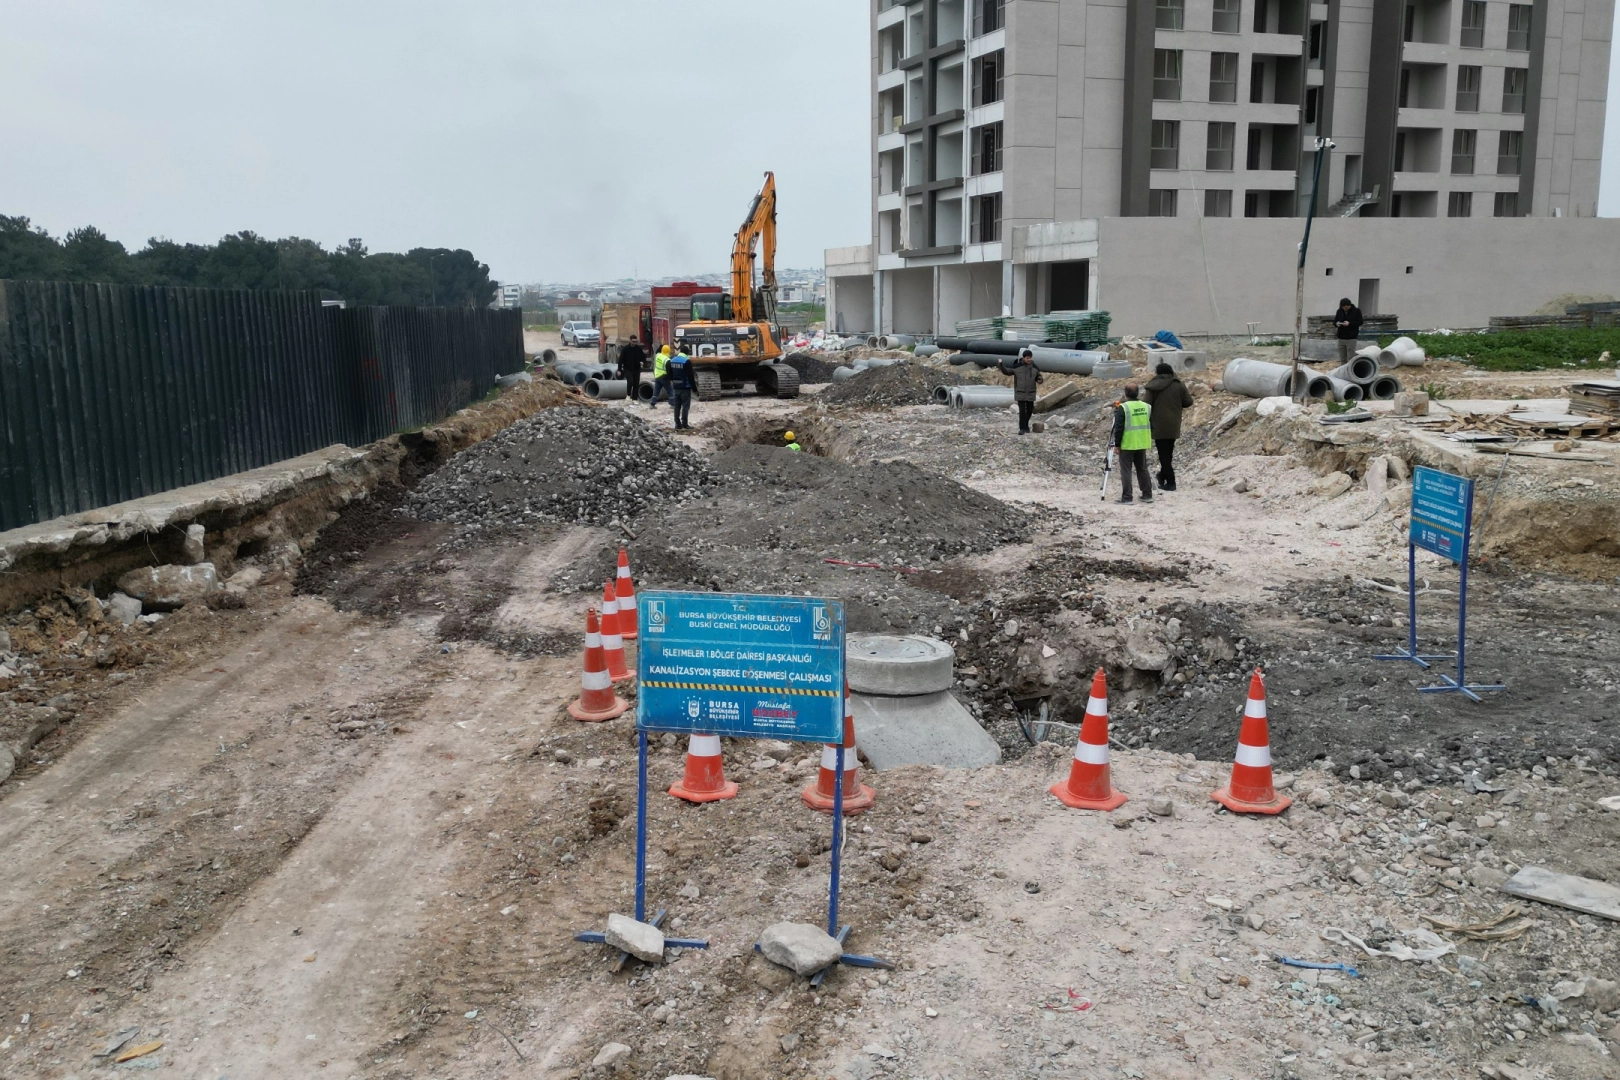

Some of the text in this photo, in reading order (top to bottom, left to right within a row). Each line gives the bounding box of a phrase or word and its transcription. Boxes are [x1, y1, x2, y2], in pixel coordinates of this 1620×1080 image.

[684, 343, 735, 358] JCB
[679, 611, 801, 623] BURSA BÜYÜKŞEHİR BELEDİYESİ
[689, 621, 791, 632] BUSKİ GENEL MÜDÜRLÜĞÜ
[662, 646, 812, 664] İŞLETMELER 1.BÖLGE DAİRESİ BAŞKANLIĞI
[649, 665, 711, 677] KANALİZASYON
[712, 668, 741, 679] ŞEBEKE
[788, 672, 832, 684] ÇALIŞMASI
[708, 700, 740, 709] BURSA
